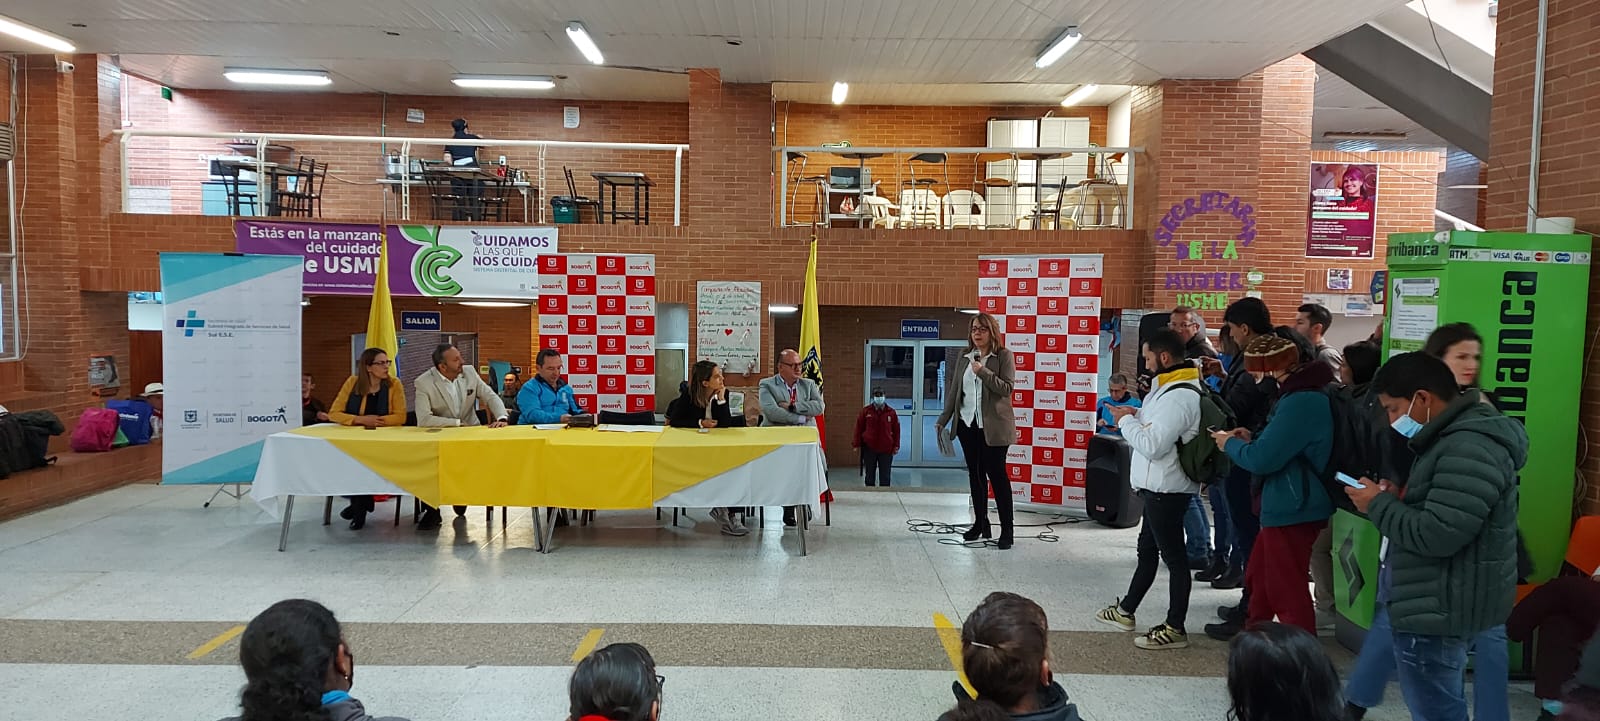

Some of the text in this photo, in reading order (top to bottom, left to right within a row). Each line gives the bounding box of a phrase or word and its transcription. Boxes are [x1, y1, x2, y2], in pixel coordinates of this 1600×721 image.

[250, 226, 382, 241] Estás en la manzana
[472, 233, 549, 248] CUIDAMOS
[306, 241, 382, 254] del cuidado
[482, 248, 500, 256] LAS
[502, 248, 523, 257] QUE
[1176, 240, 1238, 260] DE LA
[1450, 250, 1468, 260] ATM
[303, 258, 318, 273] e
[473, 257, 498, 266] NOS
[1164, 272, 1243, 290] MUJER
[1176, 292, 1228, 310] USME
[406, 317, 437, 325] SALIDA
